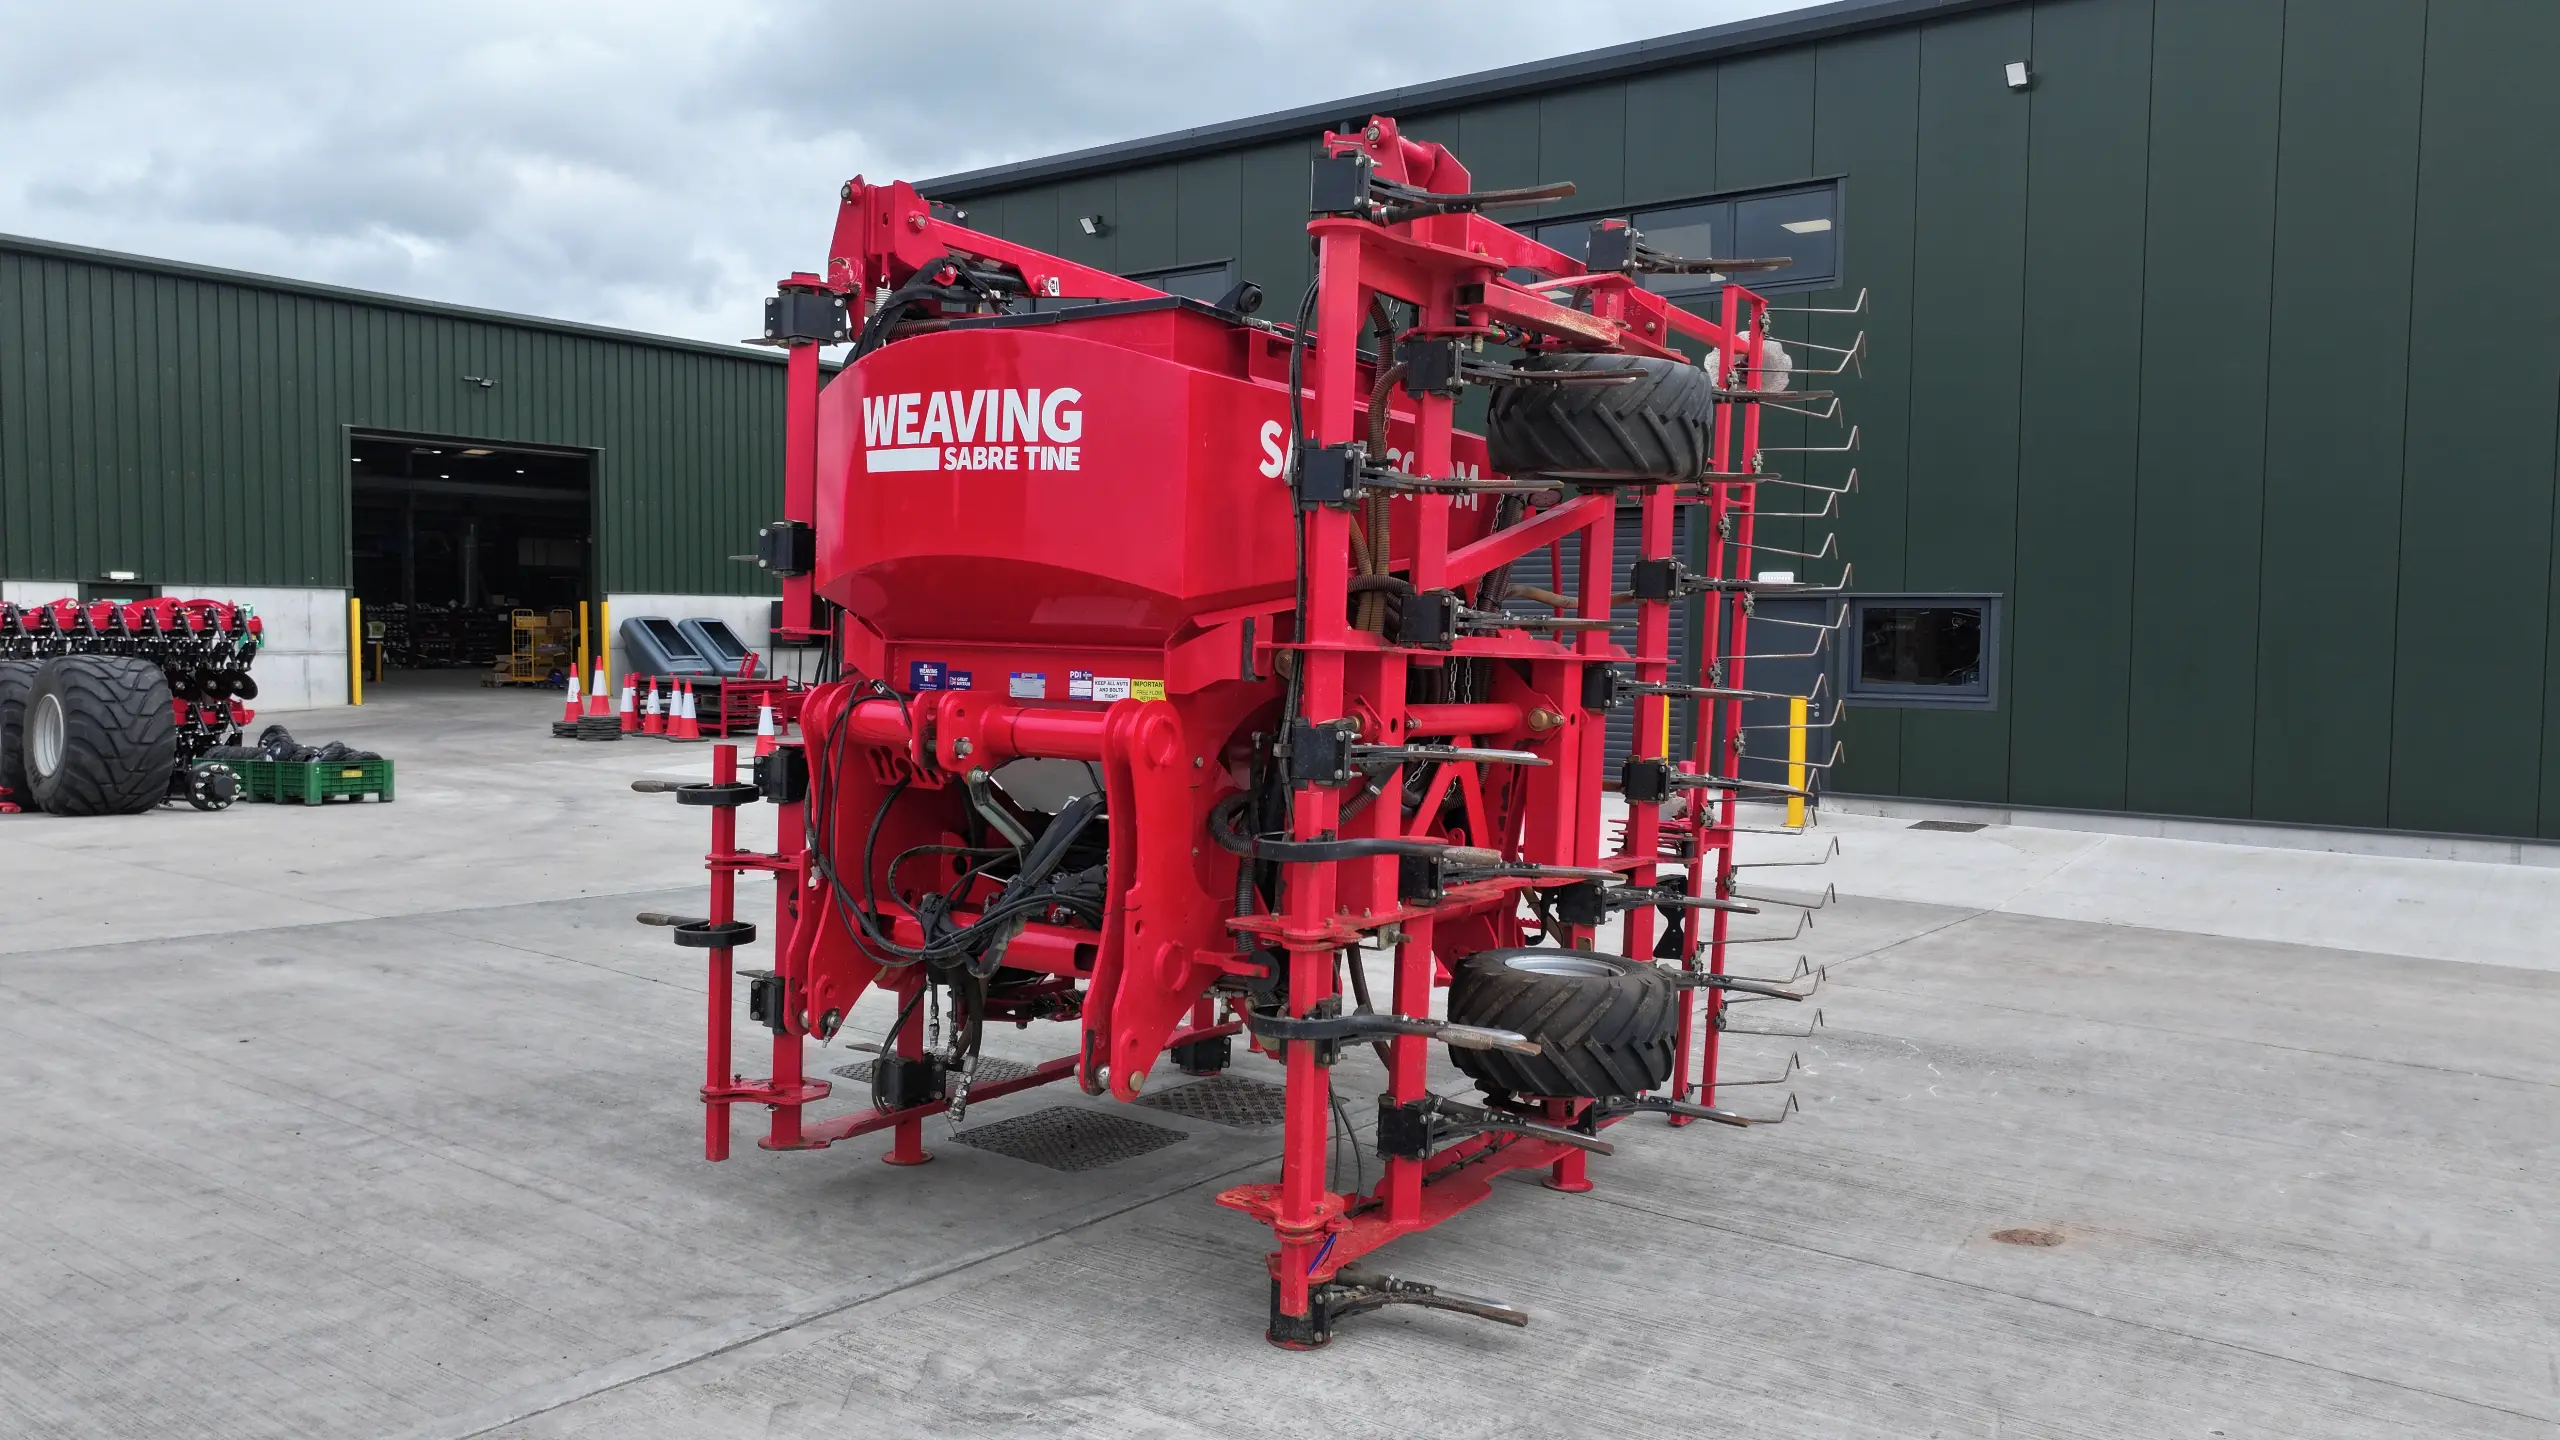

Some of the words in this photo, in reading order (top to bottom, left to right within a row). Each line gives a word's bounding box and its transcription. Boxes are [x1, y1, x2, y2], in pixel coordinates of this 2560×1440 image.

[863, 387, 1083, 447] WEAVING
[943, 446, 1018, 471] SABRE
[1024, 446, 1081, 471] TINE
[1070, 670, 1081, 679] PDI
